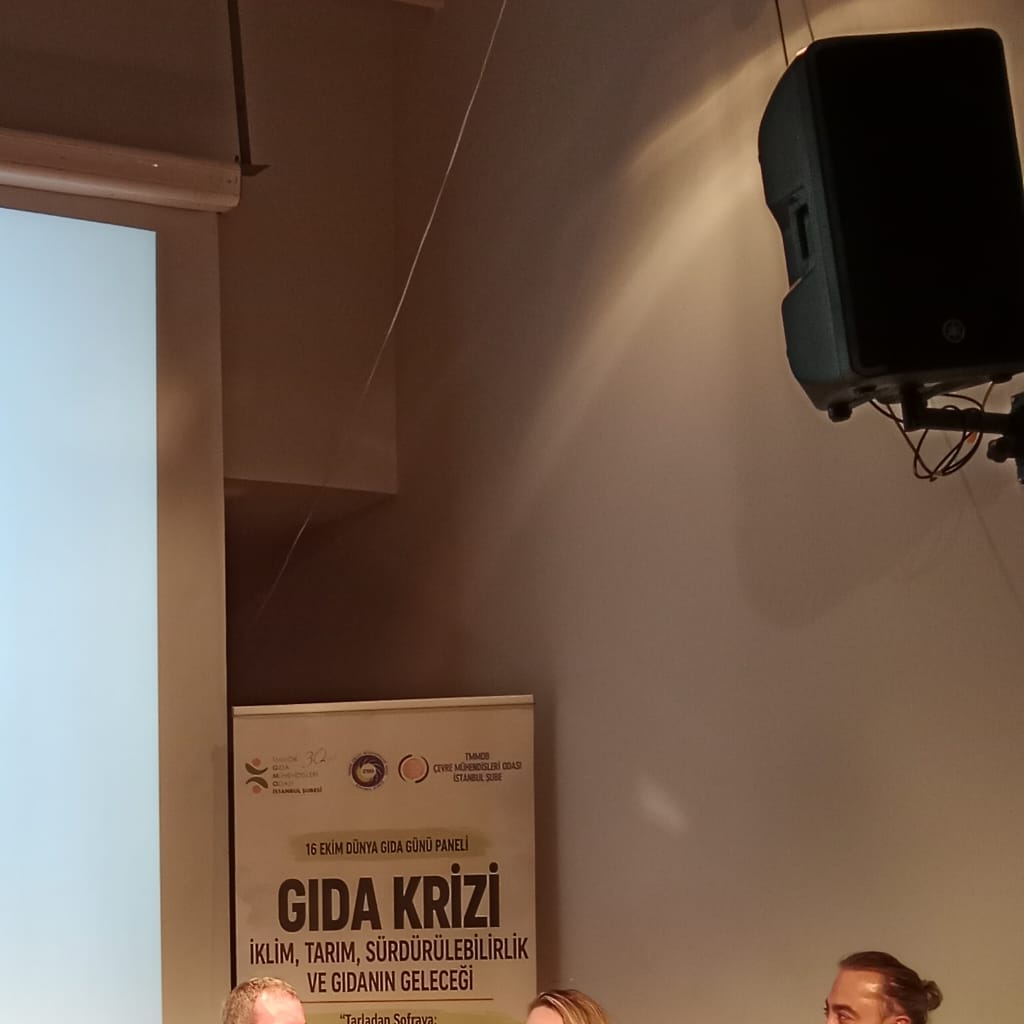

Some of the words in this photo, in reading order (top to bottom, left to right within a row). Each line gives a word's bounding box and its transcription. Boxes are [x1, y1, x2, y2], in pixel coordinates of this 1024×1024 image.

[305, 842, 317, 856] 16
[320, 839, 343, 856] EKİM
[346, 838, 378, 855] DÜNYA
[380, 840, 403, 854] GIDA
[405, 836, 433, 853] GÜNÜ
[435, 835, 469, 852] PANELİ
[277, 876, 382, 933] GIDA
[393, 862, 500, 930] KRİZİ
[249, 938, 299, 967] İKLİM,
[305, 941, 361, 967] TARIM,
[366, 932, 529, 964] SÜRDÜRÜLEBİLİRLİK
[307, 972, 326, 993] VE
[331, 971, 396, 993] GIDANIN
[401, 965, 473, 992] GELECEĞİ
